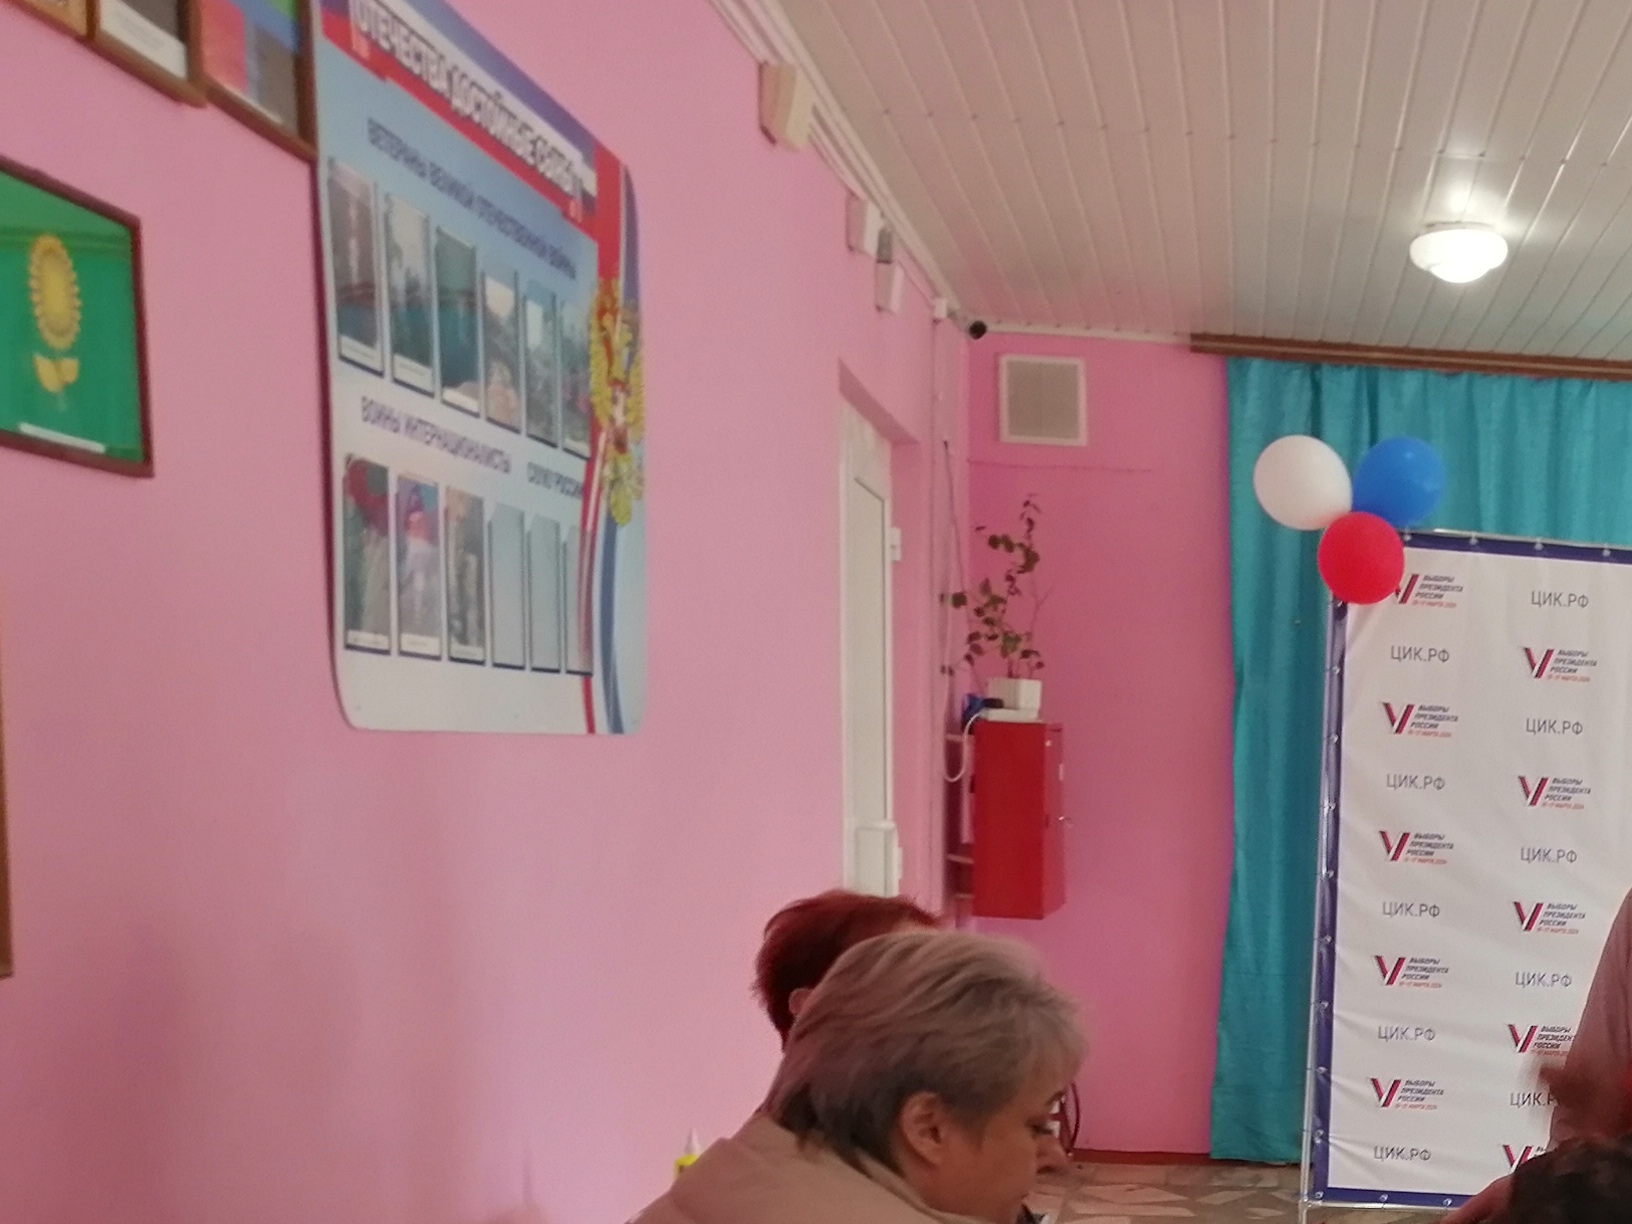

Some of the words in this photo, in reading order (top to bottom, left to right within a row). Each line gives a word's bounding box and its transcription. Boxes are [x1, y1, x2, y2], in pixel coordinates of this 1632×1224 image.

[1532, 591, 1589, 608] ЦИК.РФ
[1391, 646, 1449, 663] ЦИК.РФ
[1526, 718, 1583, 735] ЦИК.РФ
[1387, 774, 1445, 790] ЦИК.РФ
[1521, 847, 1577, 863] ЦИК.РФ
[1383, 902, 1440, 917] ЦИК.РФ
[1516, 972, 1571, 988] ЦИК.РФ
[1378, 1027, 1435, 1042] ЦИК.РФ
[1374, 1146, 1431, 1161] ЦИК.РФ
